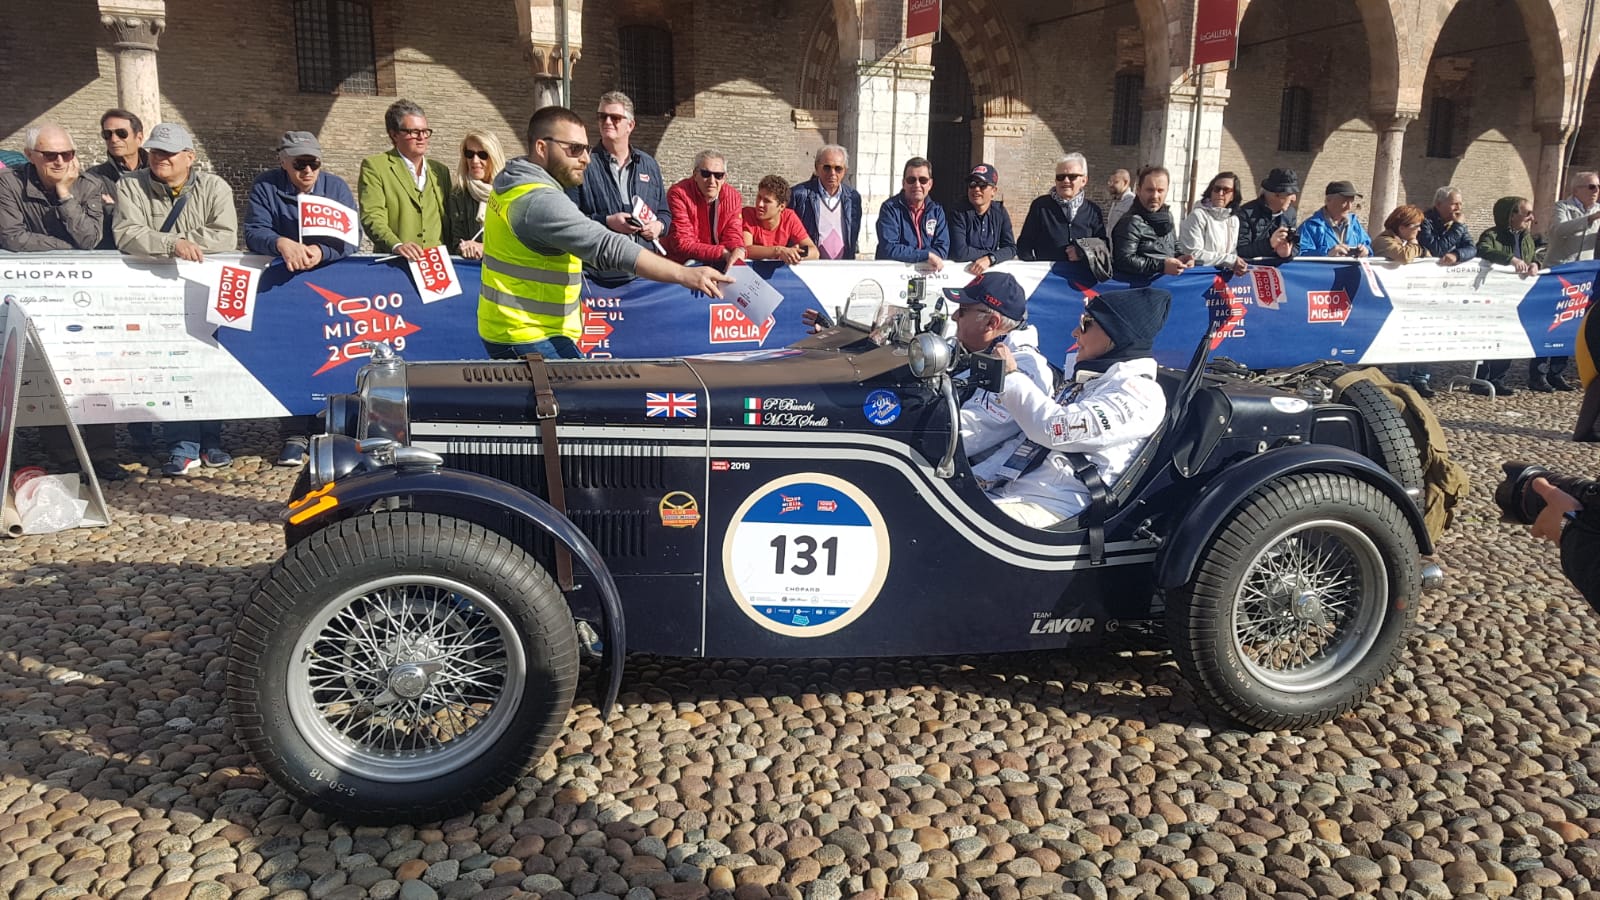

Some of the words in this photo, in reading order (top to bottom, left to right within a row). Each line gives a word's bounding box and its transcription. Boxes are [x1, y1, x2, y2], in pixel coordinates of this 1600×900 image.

[306, 204, 342, 220] 1000
[303, 215, 345, 231] MIGLIA
[419, 256, 436, 287] IGLIA
[428, 247, 446, 281] 1000
[4, 270, 93, 280] CHOPARD
[218, 267, 235, 309] MIGLIA
[232, 274, 247, 310] 1000
[1231, 285, 1252, 294] MOST
[1561, 281, 1592, 297] 1000
[325, 293, 404, 317] 1000
[585, 298, 621, 308] MOST
[1206, 297, 1254, 307] BEAUTIFUL
[1312, 294, 1341, 305] 1000
[1556, 295, 1590, 310] MIGLIA
[717, 308, 746, 321] 100
[1215, 308, 1243, 317] RACE
[1310, 308, 1344, 319] MIGLIA
[1553, 308, 1586, 324] 2019
[324, 315, 407, 340] MIGLIA
[713, 325, 760, 339] MIGLIA
[581, 339, 610, 348] HE
[778, 397, 816, 411] Bucchi
[1092, 404, 1112, 431] LAVOR
[730, 461, 751, 470] 2019
[769, 534, 838, 576] 131
[1029, 618, 1095, 634] LAVOR
